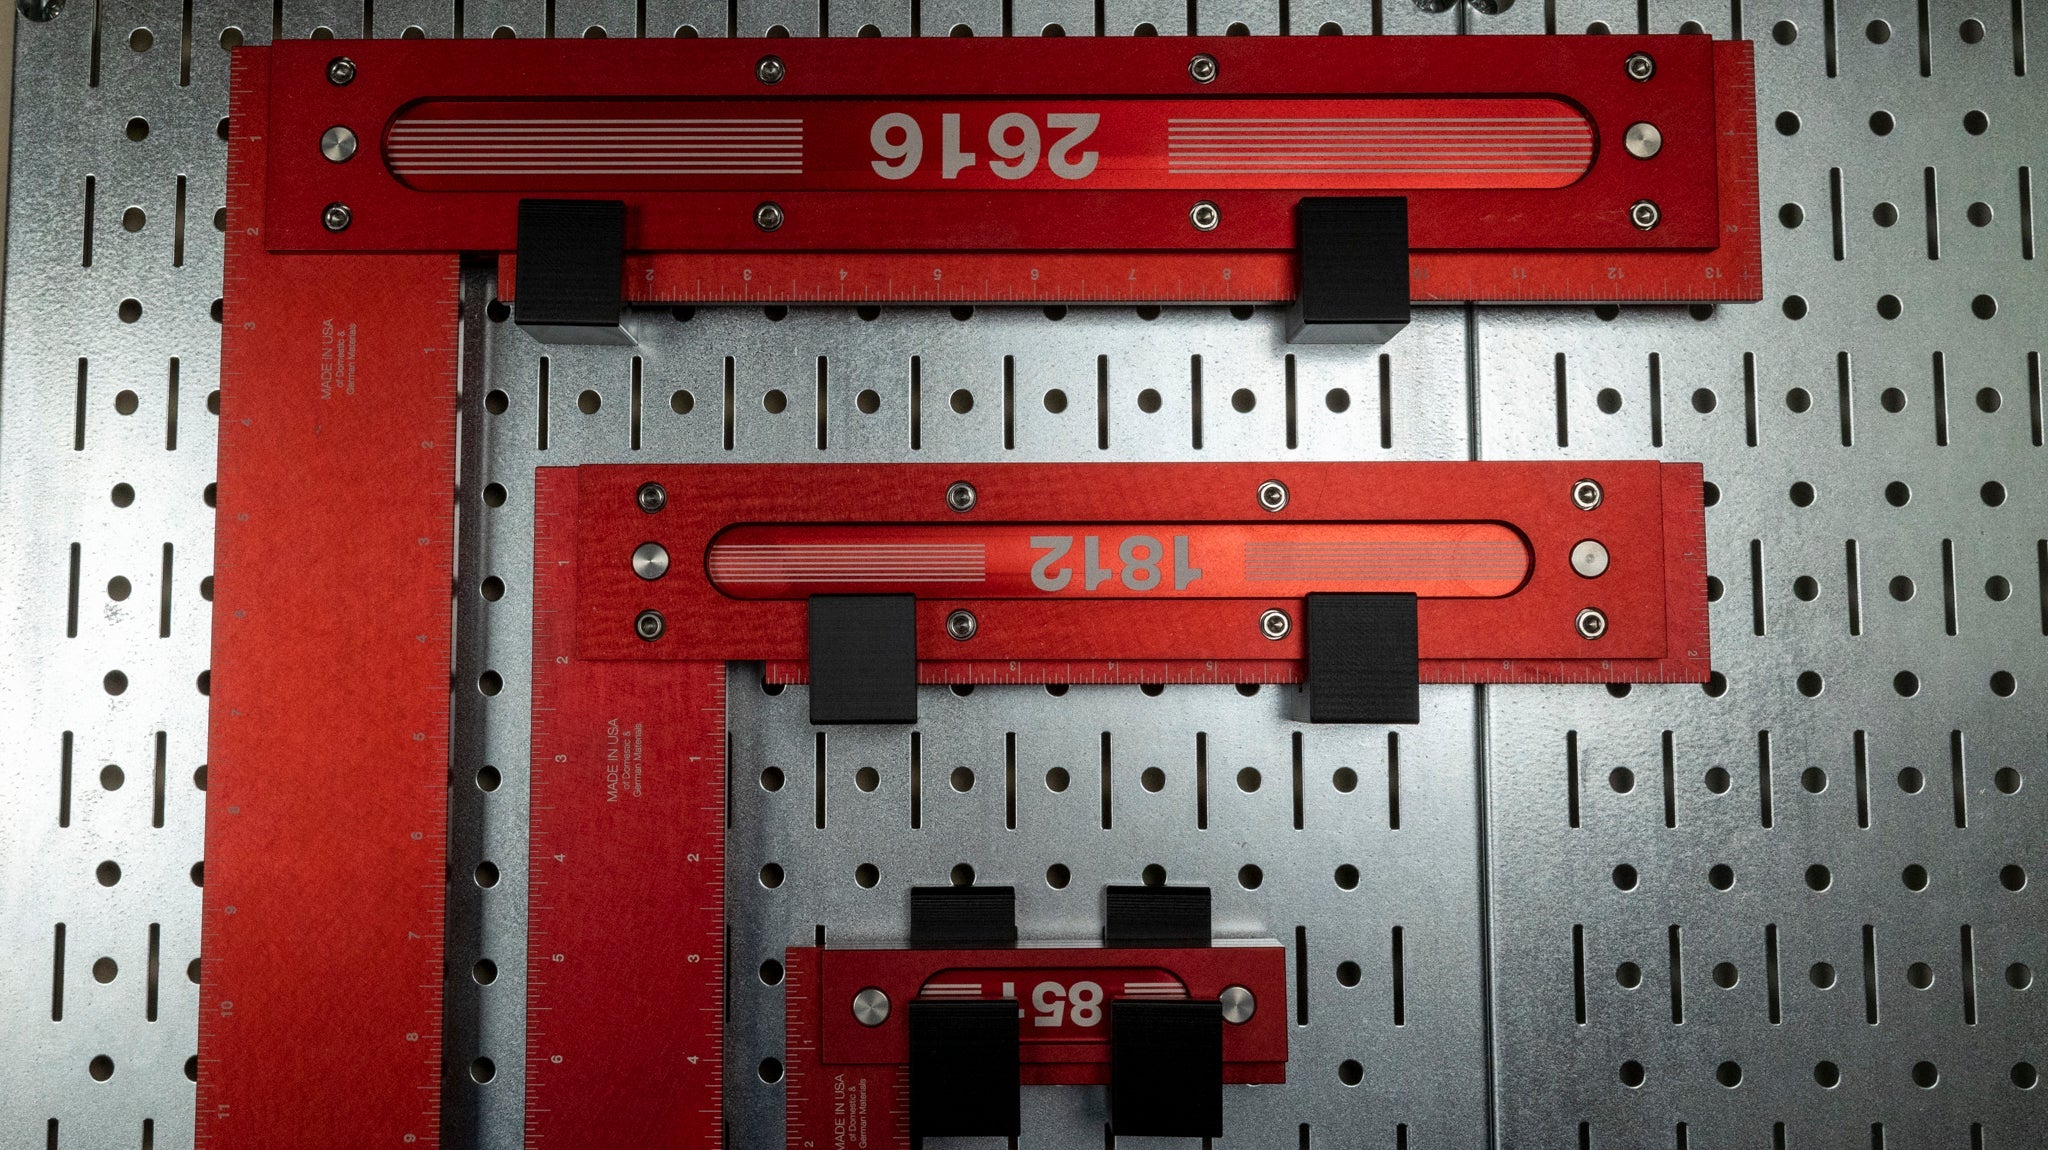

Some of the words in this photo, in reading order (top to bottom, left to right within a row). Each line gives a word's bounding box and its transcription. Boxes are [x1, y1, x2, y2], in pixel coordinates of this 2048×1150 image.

[249, 135, 262, 143] 1
[870, 112, 1101, 180] 2616
[247, 227, 259, 236] 2
[1726, 224, 1738, 233] 2
[646, 269, 655, 281] 2
[743, 269, 752, 281] 3
[838, 269, 848, 281] 4
[933, 269, 942, 281] 5
[1029, 269, 1039, 281] 6
[1128, 269, 1137, 281] 7
[1222, 268, 1231, 280] 8
[1511, 268, 1527, 279] 11
[1607, 267, 1625, 279] 12
[1705, 267, 1722, 279] 13
[244, 321, 255, 330] 3
[323, 319, 333, 344] USA
[348, 323, 356, 359] Materials
[322, 348, 332, 359] IN
[336, 339, 345, 377] Domestic
[321, 363, 332, 399] MADE
[347, 362, 355, 394] German
[336, 380, 343, 388] of
[241, 418, 251, 427] 4
[421, 441, 433, 450] 2
[418, 537, 430, 547] 3
[1030, 535, 1202, 591] 1812
[416, 634, 427, 643] 4
[556, 655, 568, 665] 2
[1503, 660, 1510, 670] 8
[1602, 660, 1609, 670] 9
[1010, 661, 1017, 671] 3
[1108, 661, 1115, 670] 4
[1206, 661, 1213, 671] 5
[608, 718, 618, 744] USA
[413, 732, 425, 741] 5
[634, 723, 642, 760] Materials
[555, 754, 567, 764] 3
[607, 749, 618, 760] IN
[689, 755, 702, 763] 1
[607, 765, 618, 802] MADE
[633, 764, 641, 797] German
[411, 831, 423, 841] 6
[554, 854, 566, 862] 4
[687, 852, 699, 862] 2
[224, 905, 236, 915] 9
[408, 931, 420, 940] 7
[552, 953, 564, 963] 5
[687, 953, 700, 963] 3
[221, 1000, 233, 1017] 10
[406, 1032, 418, 1042] 8
[551, 1054, 563, 1064] 6
[687, 1055, 699, 1064] 4
[835, 1074, 845, 1099] USA
[218, 1104, 230, 1119] 11
[835, 1103, 845, 1114] IN
[835, 1118, 845, 1150] MADE
[859, 1117, 867, 1148] German
[404, 1133, 416, 1143] 9
